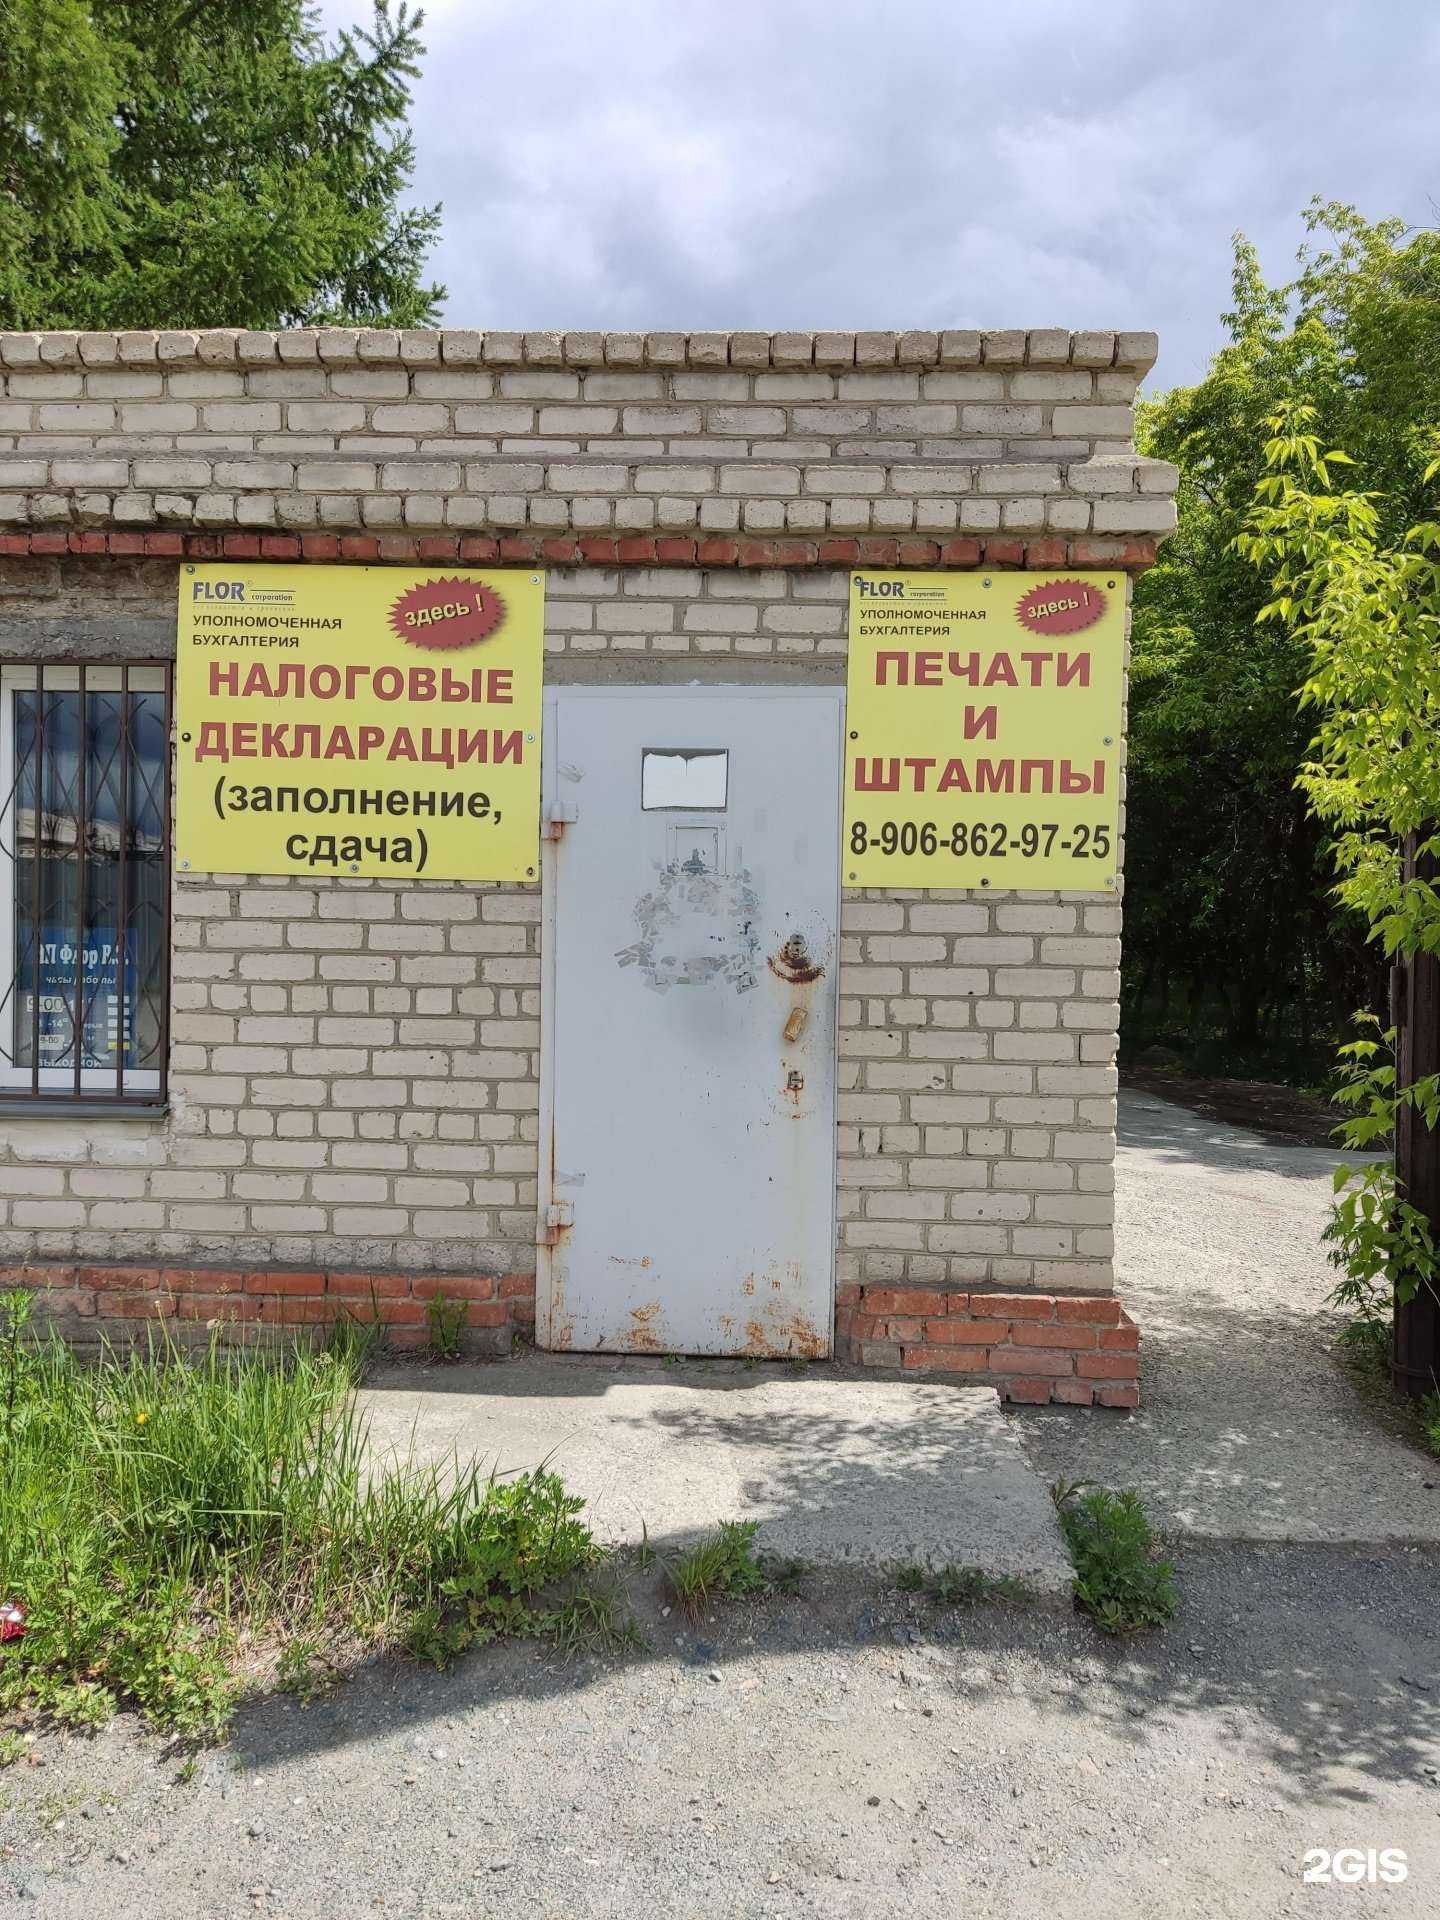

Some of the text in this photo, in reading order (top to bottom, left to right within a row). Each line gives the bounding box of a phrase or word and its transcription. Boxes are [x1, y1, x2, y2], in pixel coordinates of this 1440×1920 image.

[193, 581, 245, 602] FLOR
[859, 582, 905, 599] FLOR
[193, 615, 342, 629] УПОЛНОМОЧЕННАЯ
[403, 601, 470, 627] здесь
[860, 609, 986, 620] УПОЛНОМОЧЕННАЯ
[1027, 595, 1080, 619] здесь
[193, 634, 299, 648] БУХГАЛТЕРИЯ
[860, 625, 950, 636] БУХГАЛТЕРИЯ
[208, 661, 514, 704] НАЛОГОВЫЕ
[875, 651, 1091, 687] ПЕЧАТИ
[963, 705, 998, 740] И
[195, 721, 524, 769] ДЕКЛАРАЦИИ
[854, 757, 1105, 795] ШТАМПЫ
[214, 776, 503, 825] (заполнение,
[286, 828, 429, 872] сдача)
[850, 821, 1111, 858] 8-906-862-97-25
